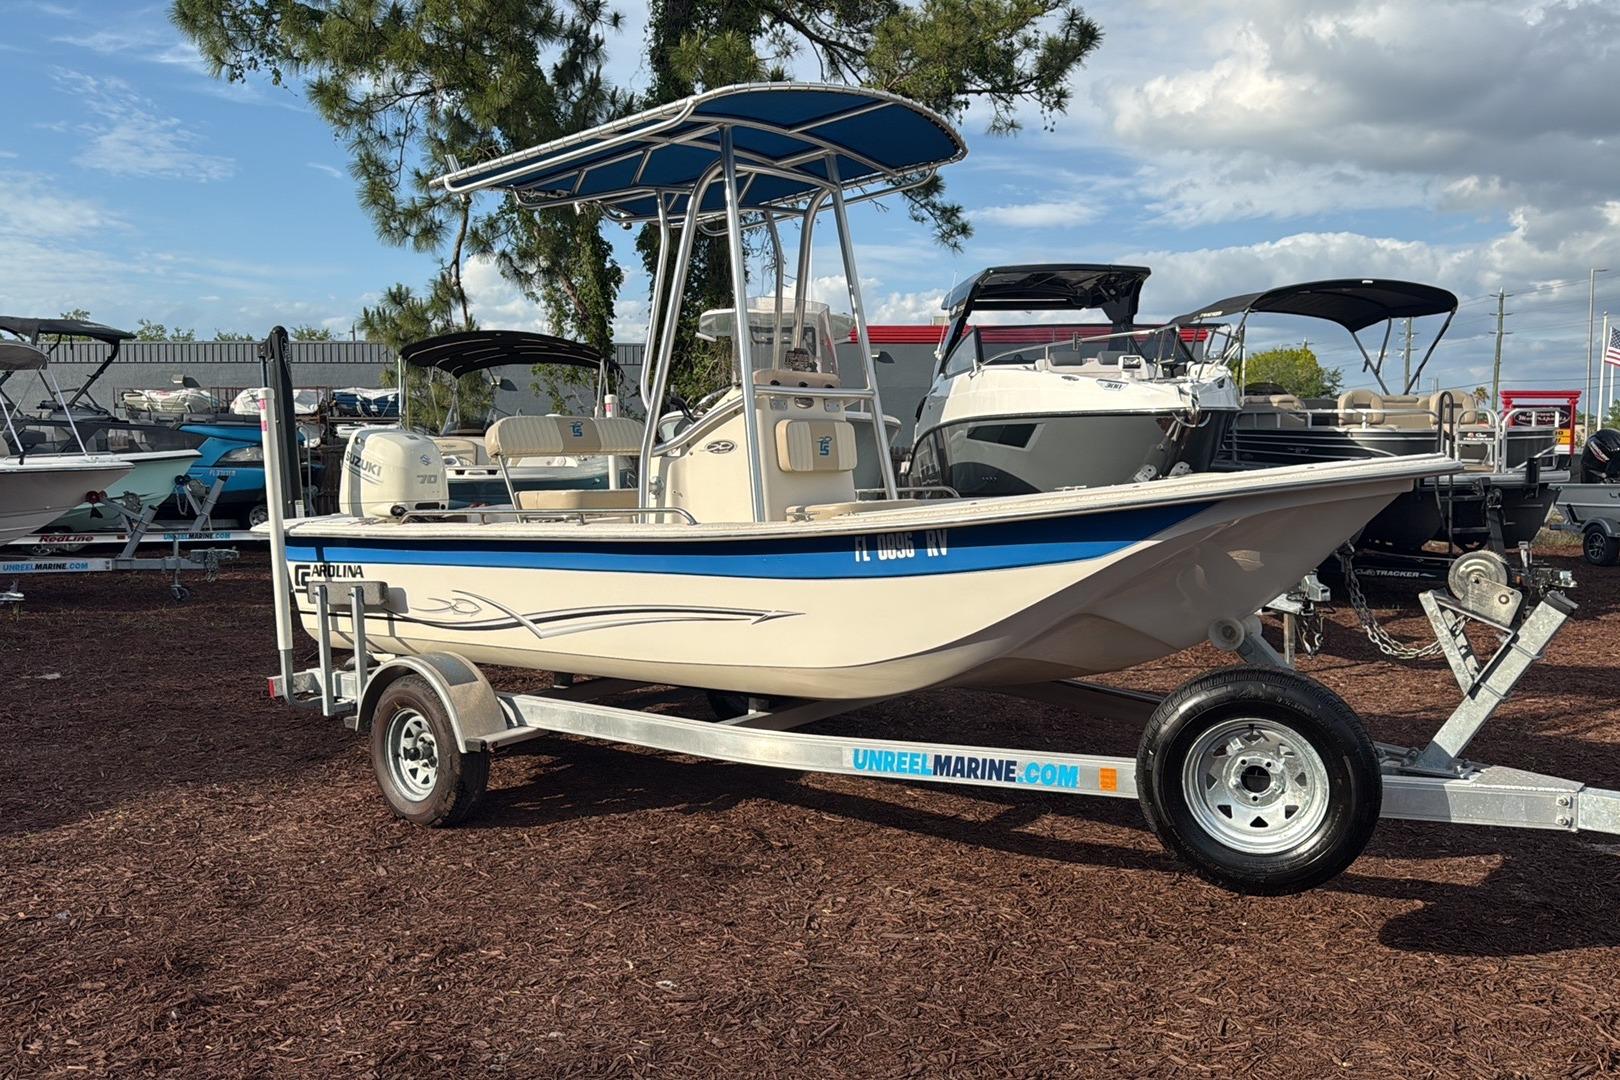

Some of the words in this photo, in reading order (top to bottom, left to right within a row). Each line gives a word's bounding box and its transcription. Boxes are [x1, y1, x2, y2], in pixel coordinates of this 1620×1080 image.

[345, 451, 382, 477] SUZUKI
[417, 474, 437, 484] 70
[163, 532, 231, 540] UNEELMARINE.COM
[854, 535, 871, 562] FL
[925, 528, 948, 557] RV
[853, 749, 1079, 788] UNREELMARINE.COM
